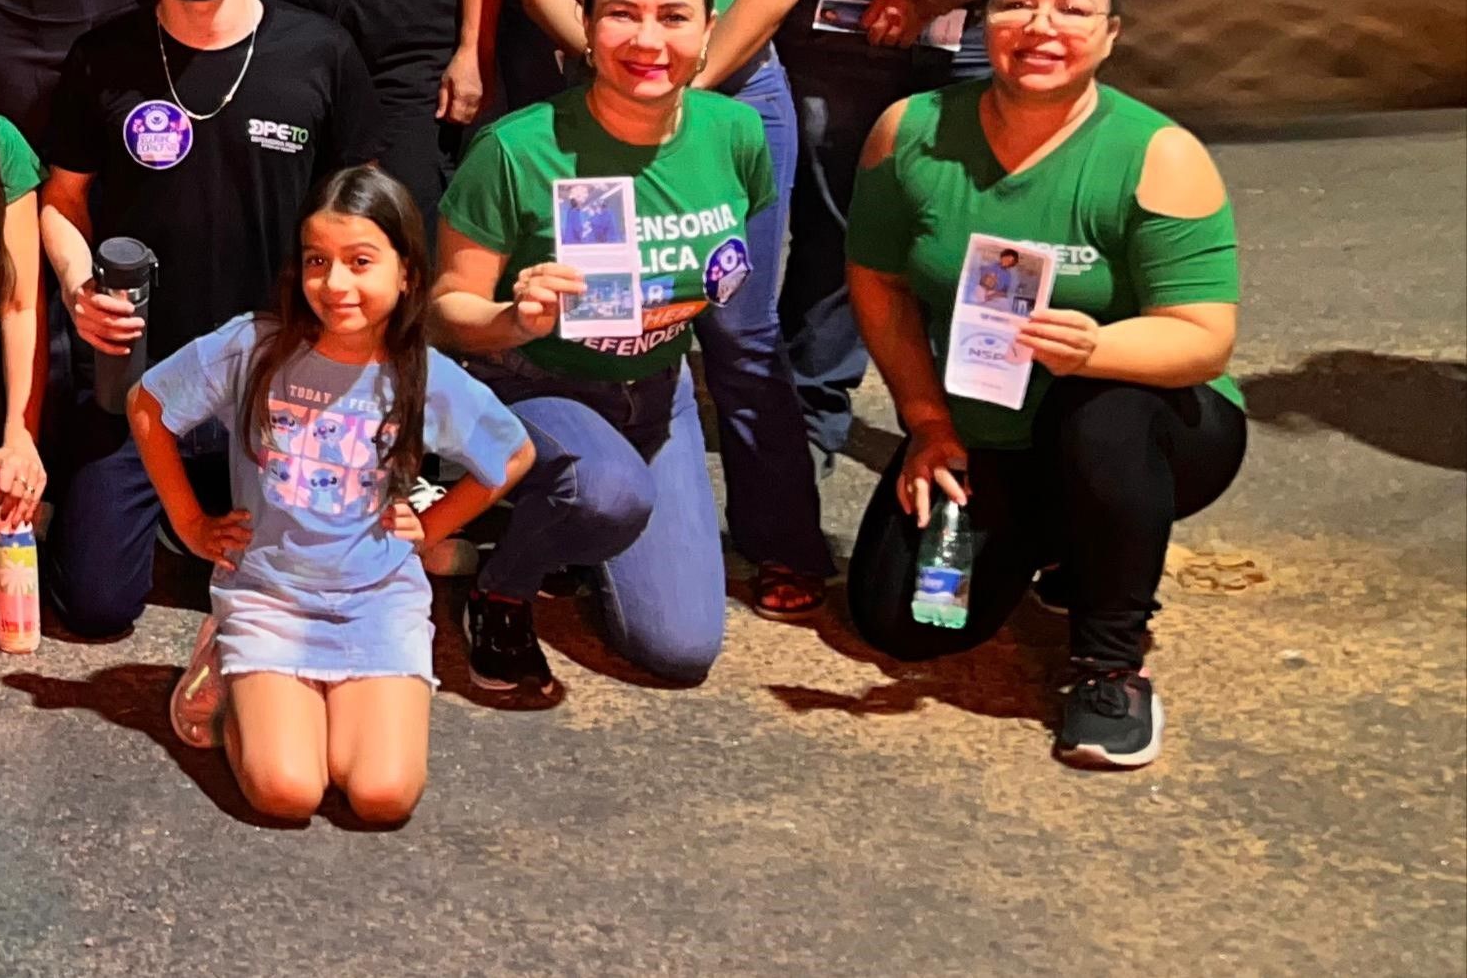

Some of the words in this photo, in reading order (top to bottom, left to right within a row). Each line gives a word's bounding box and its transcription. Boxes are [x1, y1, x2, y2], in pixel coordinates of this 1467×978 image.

[636, 204, 738, 242] ENSORIA
[639, 245, 700, 273] LICA
[579, 321, 689, 356] EFENDER
[290, 385, 332, 404] TODAY
